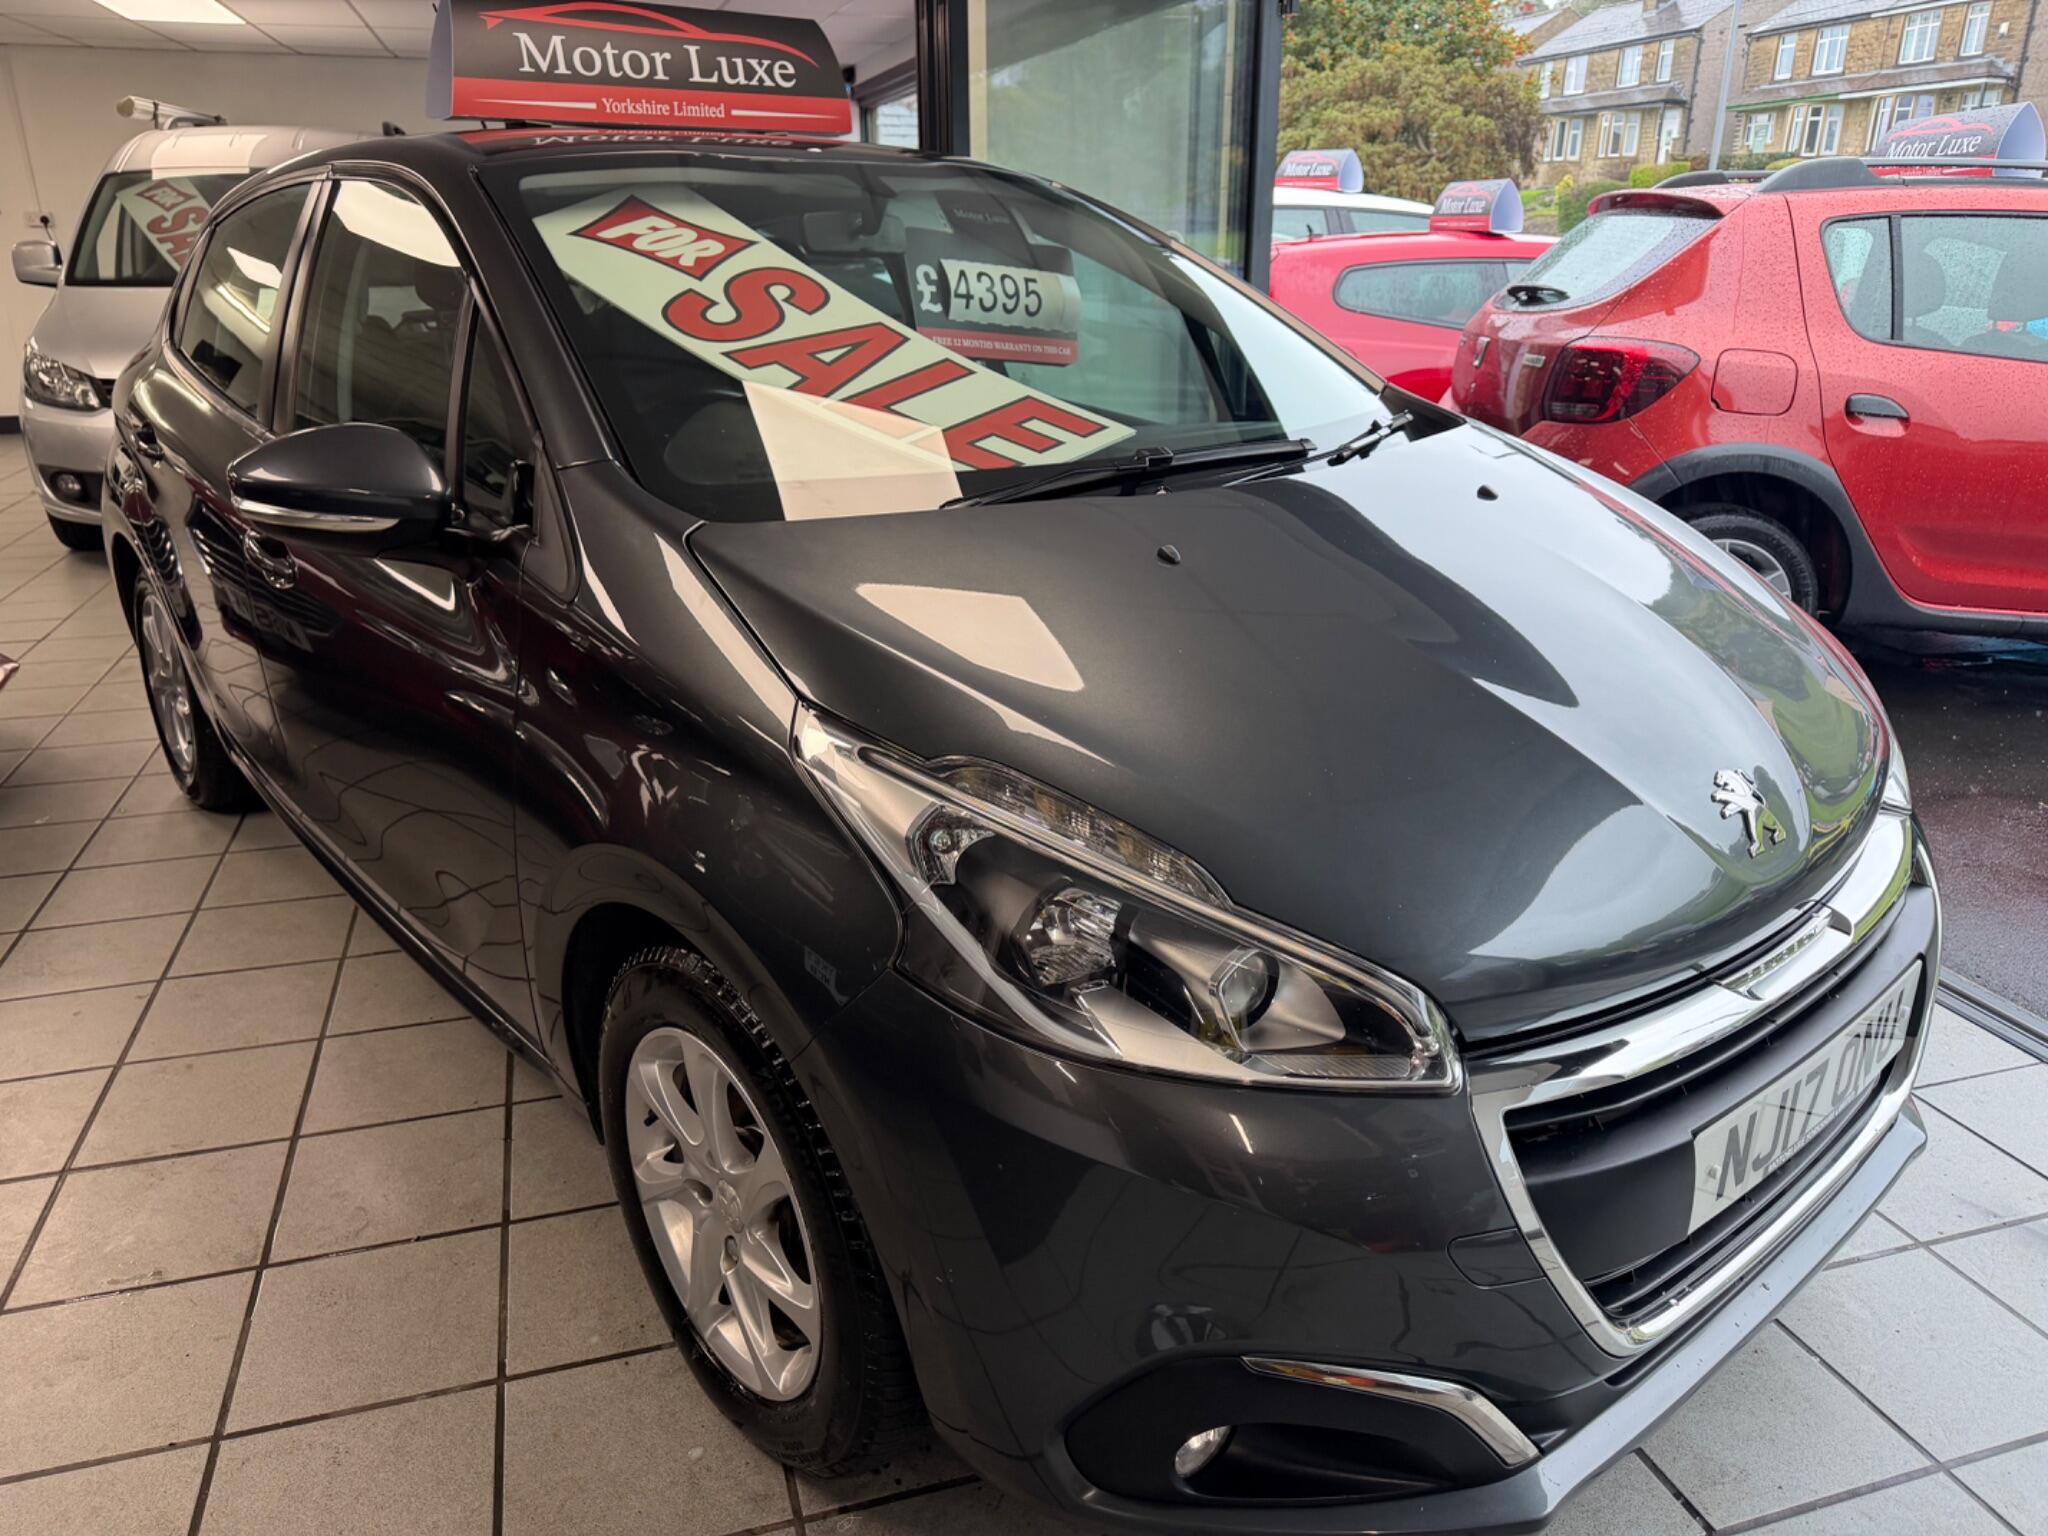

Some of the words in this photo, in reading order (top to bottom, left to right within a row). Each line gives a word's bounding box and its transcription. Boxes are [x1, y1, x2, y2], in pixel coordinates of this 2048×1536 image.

[512, 32, 672, 80] Motor
[682, 44, 798, 88] Luxe
[601, 97, 671, 117] Yorkshire
[673, 101, 726, 119] Limited
[1886, 141, 1936, 158] Motor
[1935, 134, 1982, 156] Luxe
[595, 216, 727, 268] FOR
[660, 265, 1110, 469] SALE
[1715, 1057, 1831, 1201] NJ17
